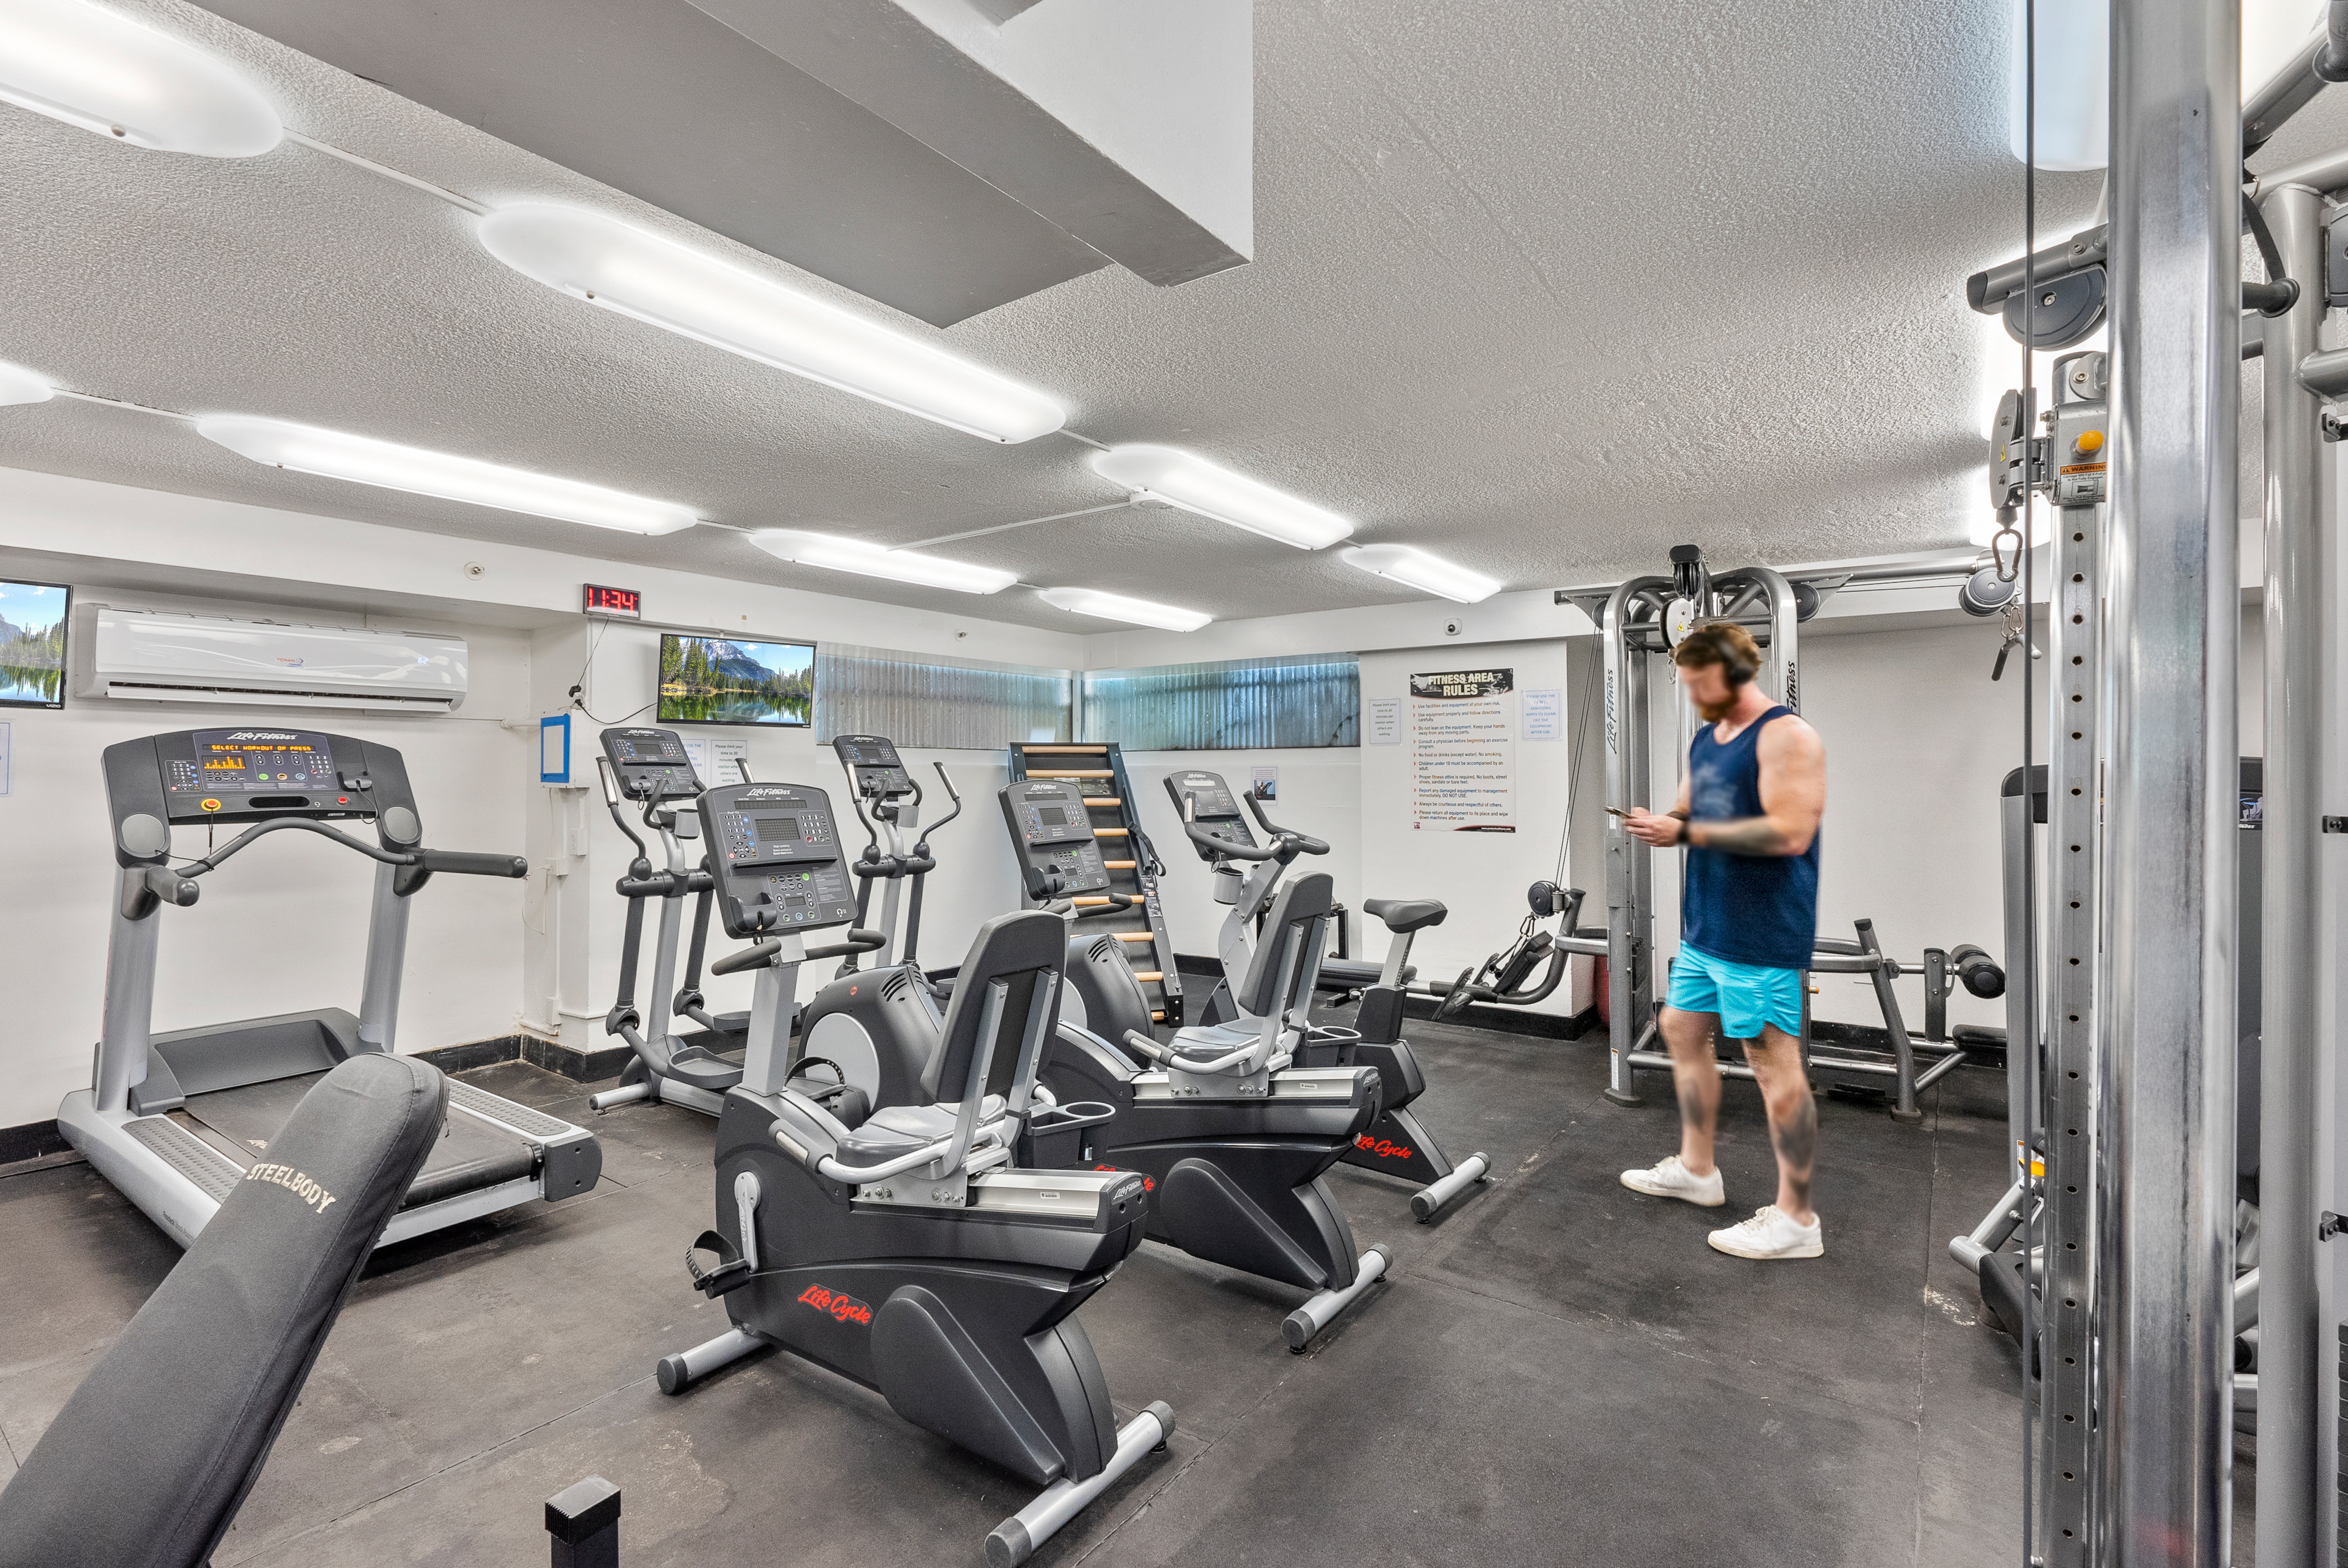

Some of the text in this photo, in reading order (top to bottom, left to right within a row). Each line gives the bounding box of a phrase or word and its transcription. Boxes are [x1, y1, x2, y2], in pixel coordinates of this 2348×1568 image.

[589, 587, 634, 615] 11:34
[1428, 672, 1494, 685] FITNESS AREA
[1443, 684, 1478, 696] RULES
[1606, 669, 1617, 755] Life Fitness
[227, 732, 297, 741] Life Fitness
[1374, 1140, 1412, 1159] Cycle
[246, 1163, 337, 1214] STEELBODY
[798, 1286, 871, 1324] Life Cycle
